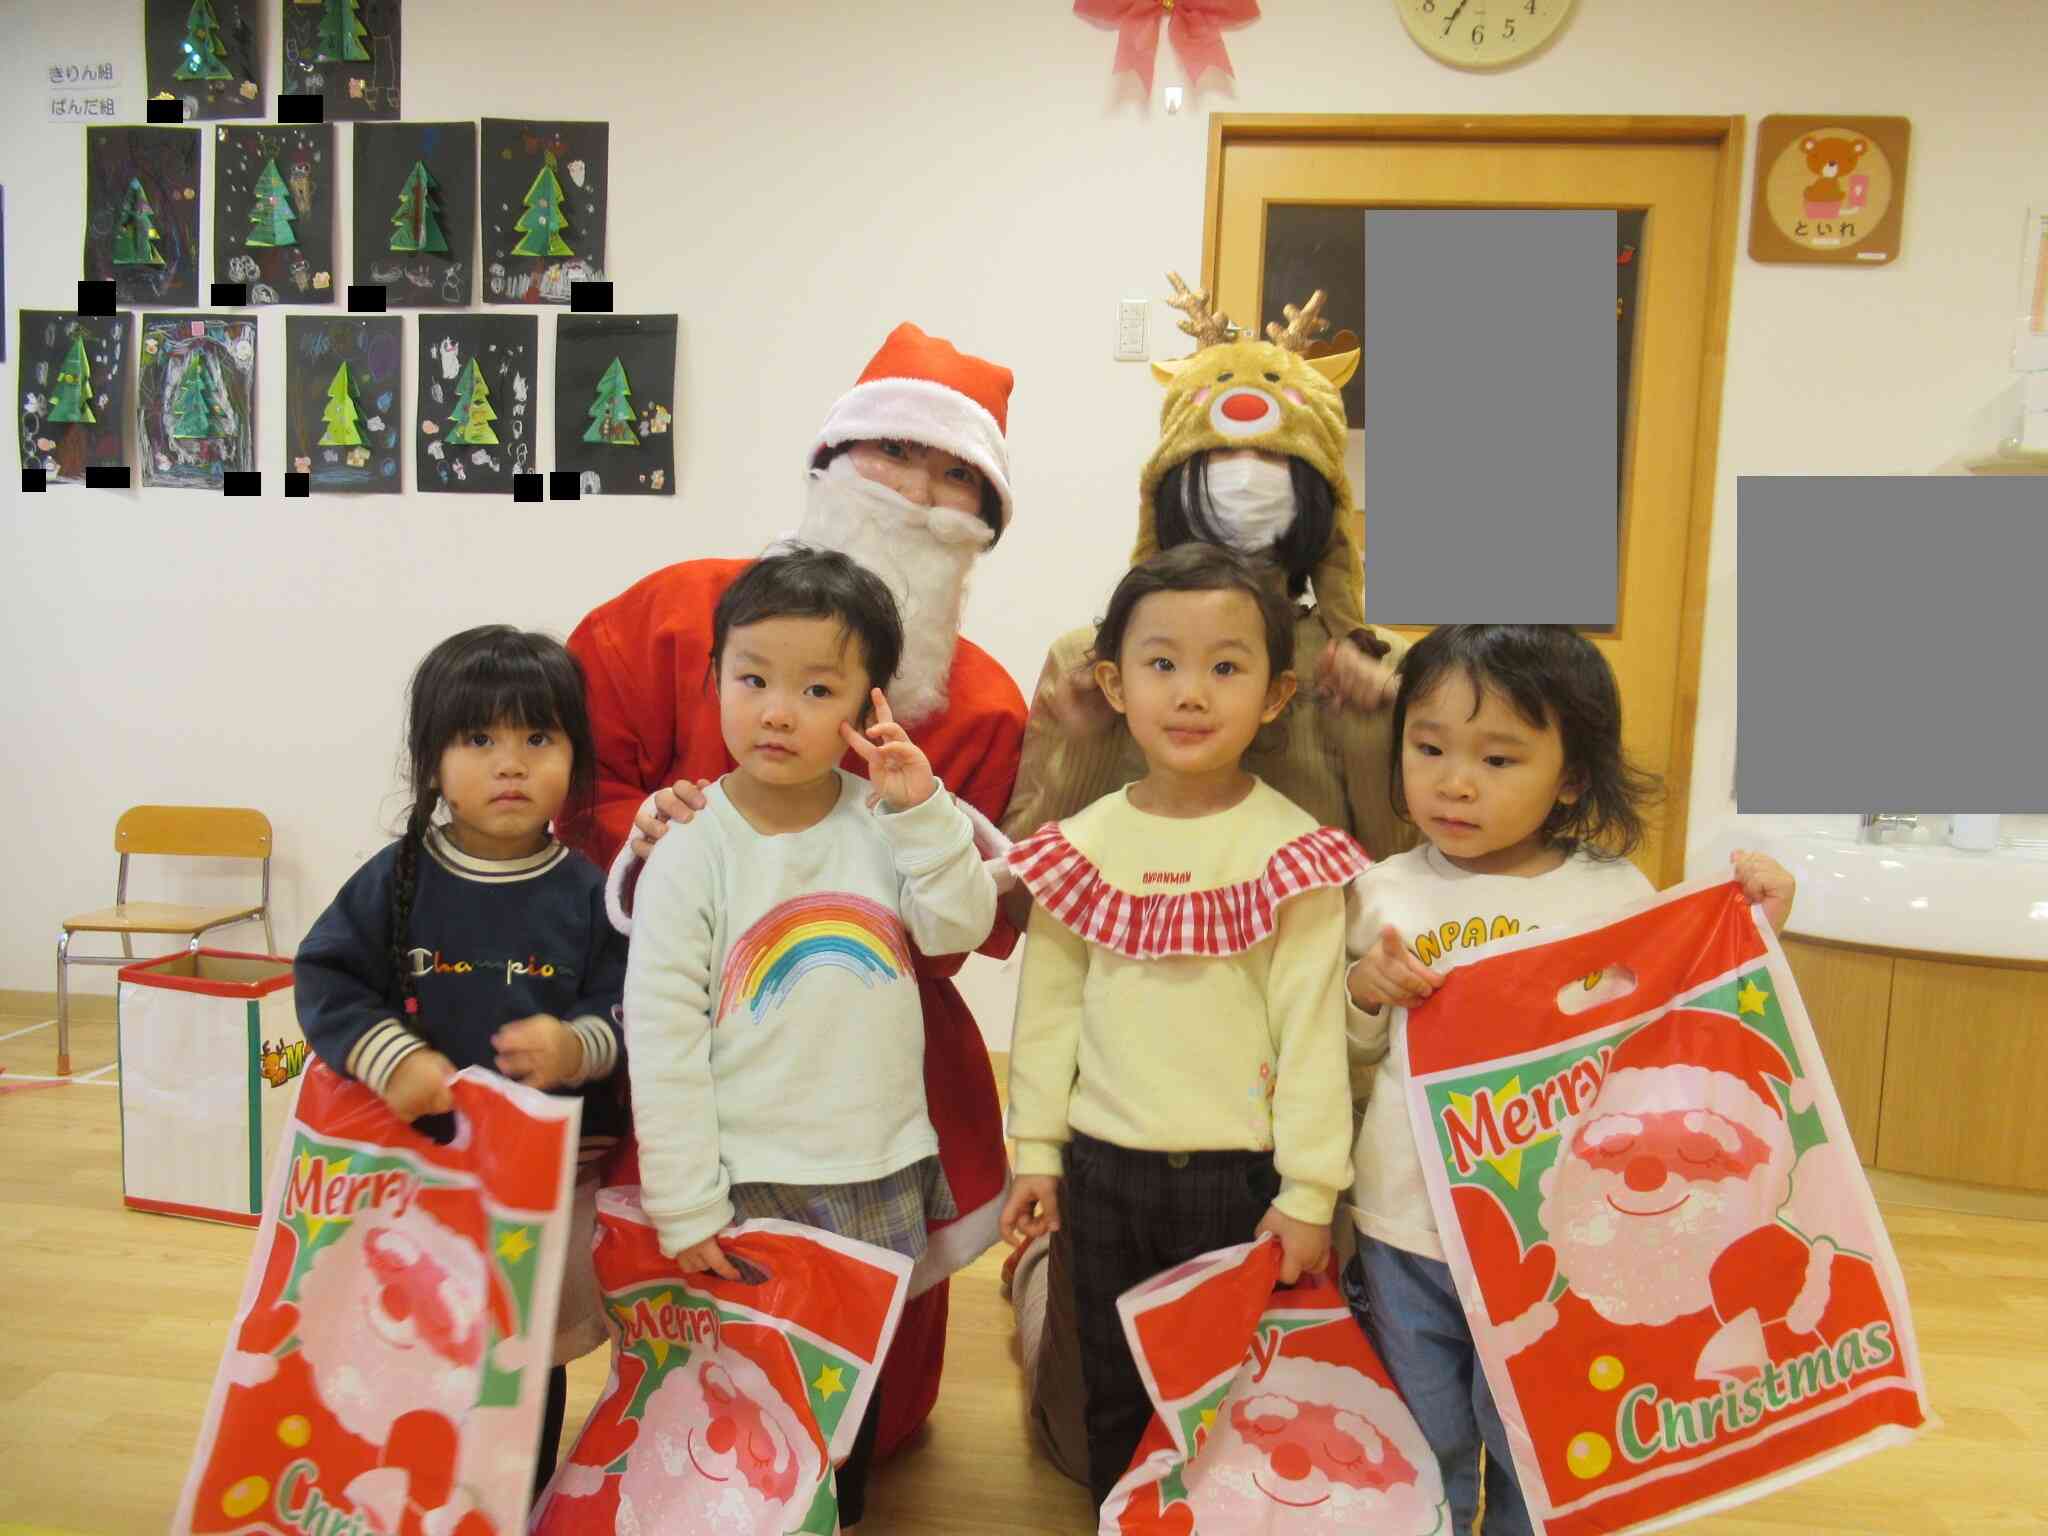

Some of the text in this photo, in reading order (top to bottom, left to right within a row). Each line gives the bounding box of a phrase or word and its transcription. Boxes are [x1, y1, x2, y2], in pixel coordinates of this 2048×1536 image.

[1471, 25, 1486, 46] 6
[1502, 18, 1516, 39] 5
[49, 62, 113, 84] きりん組
[1794, 221, 1857, 237] といれ
[1441, 1046, 1613, 1175] Merry
[283, 1157, 421, 1219] Merry
[622, 1300, 721, 1353] Merry
[1619, 1321, 1894, 1462] Christmas
